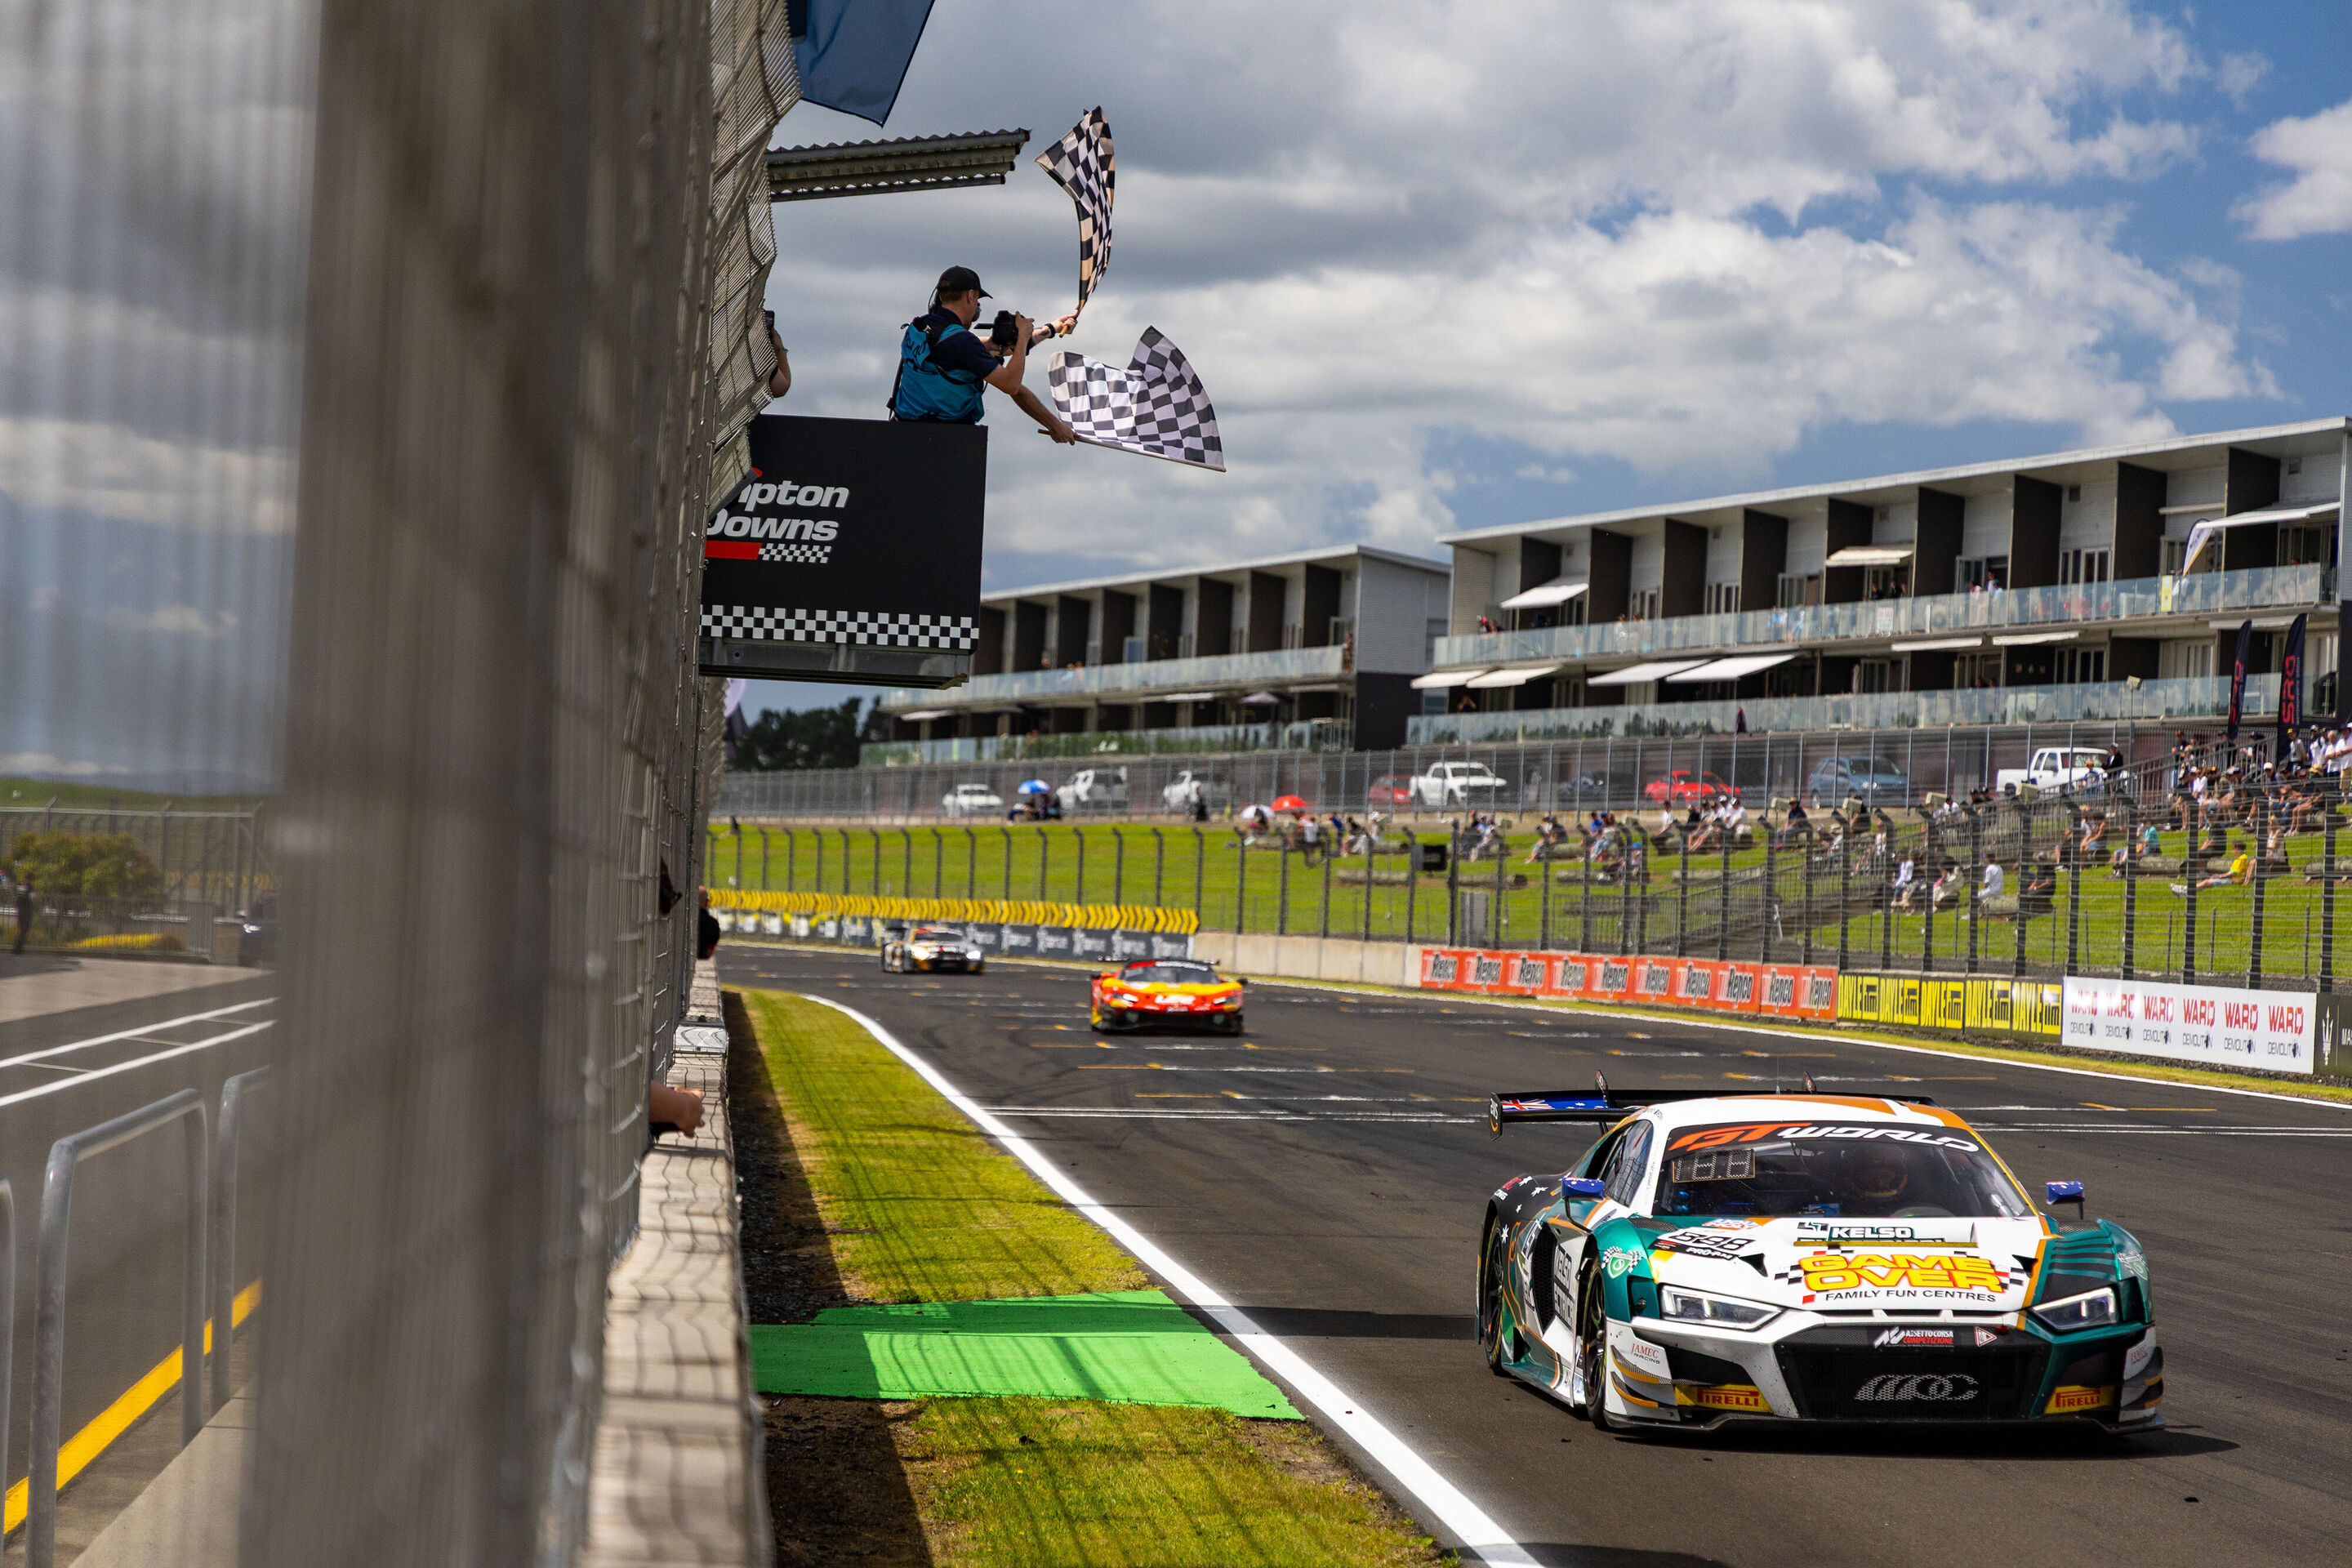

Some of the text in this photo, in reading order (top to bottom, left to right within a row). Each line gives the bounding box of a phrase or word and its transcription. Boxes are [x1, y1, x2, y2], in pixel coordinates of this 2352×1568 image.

[738, 480, 849, 511] pton
[2282, 655, 2296, 724] SRO
[1921, 981, 1946, 1027] DAYLE
[1965, 980, 1993, 1027] DAYLE
[2183, 998, 2216, 1027] WARD
[2225, 1001, 2258, 1031] WARD
[2268, 1005, 2304, 1035] WARD
[1777, 1126, 1980, 1152] WORLD
[1668, 1232, 1756, 1251] 598
[1831, 1227, 1913, 1240] KELSO
[1799, 1254, 1995, 1276] GAME
[1805, 1267, 2006, 1293] OVER
[1825, 1290, 1996, 1302] FAMILY FUN CENTRES
[1903, 1336, 1953, 1344] COMPETIZIONE
[1933, 1330, 1953, 1338] CORSA
[1631, 1343, 1659, 1358] JAMEC
[1633, 1352, 1660, 1365] RACING
[1697, 1388, 1760, 1407] PIRELLI
[2056, 1388, 2101, 1408] PIRELLI
